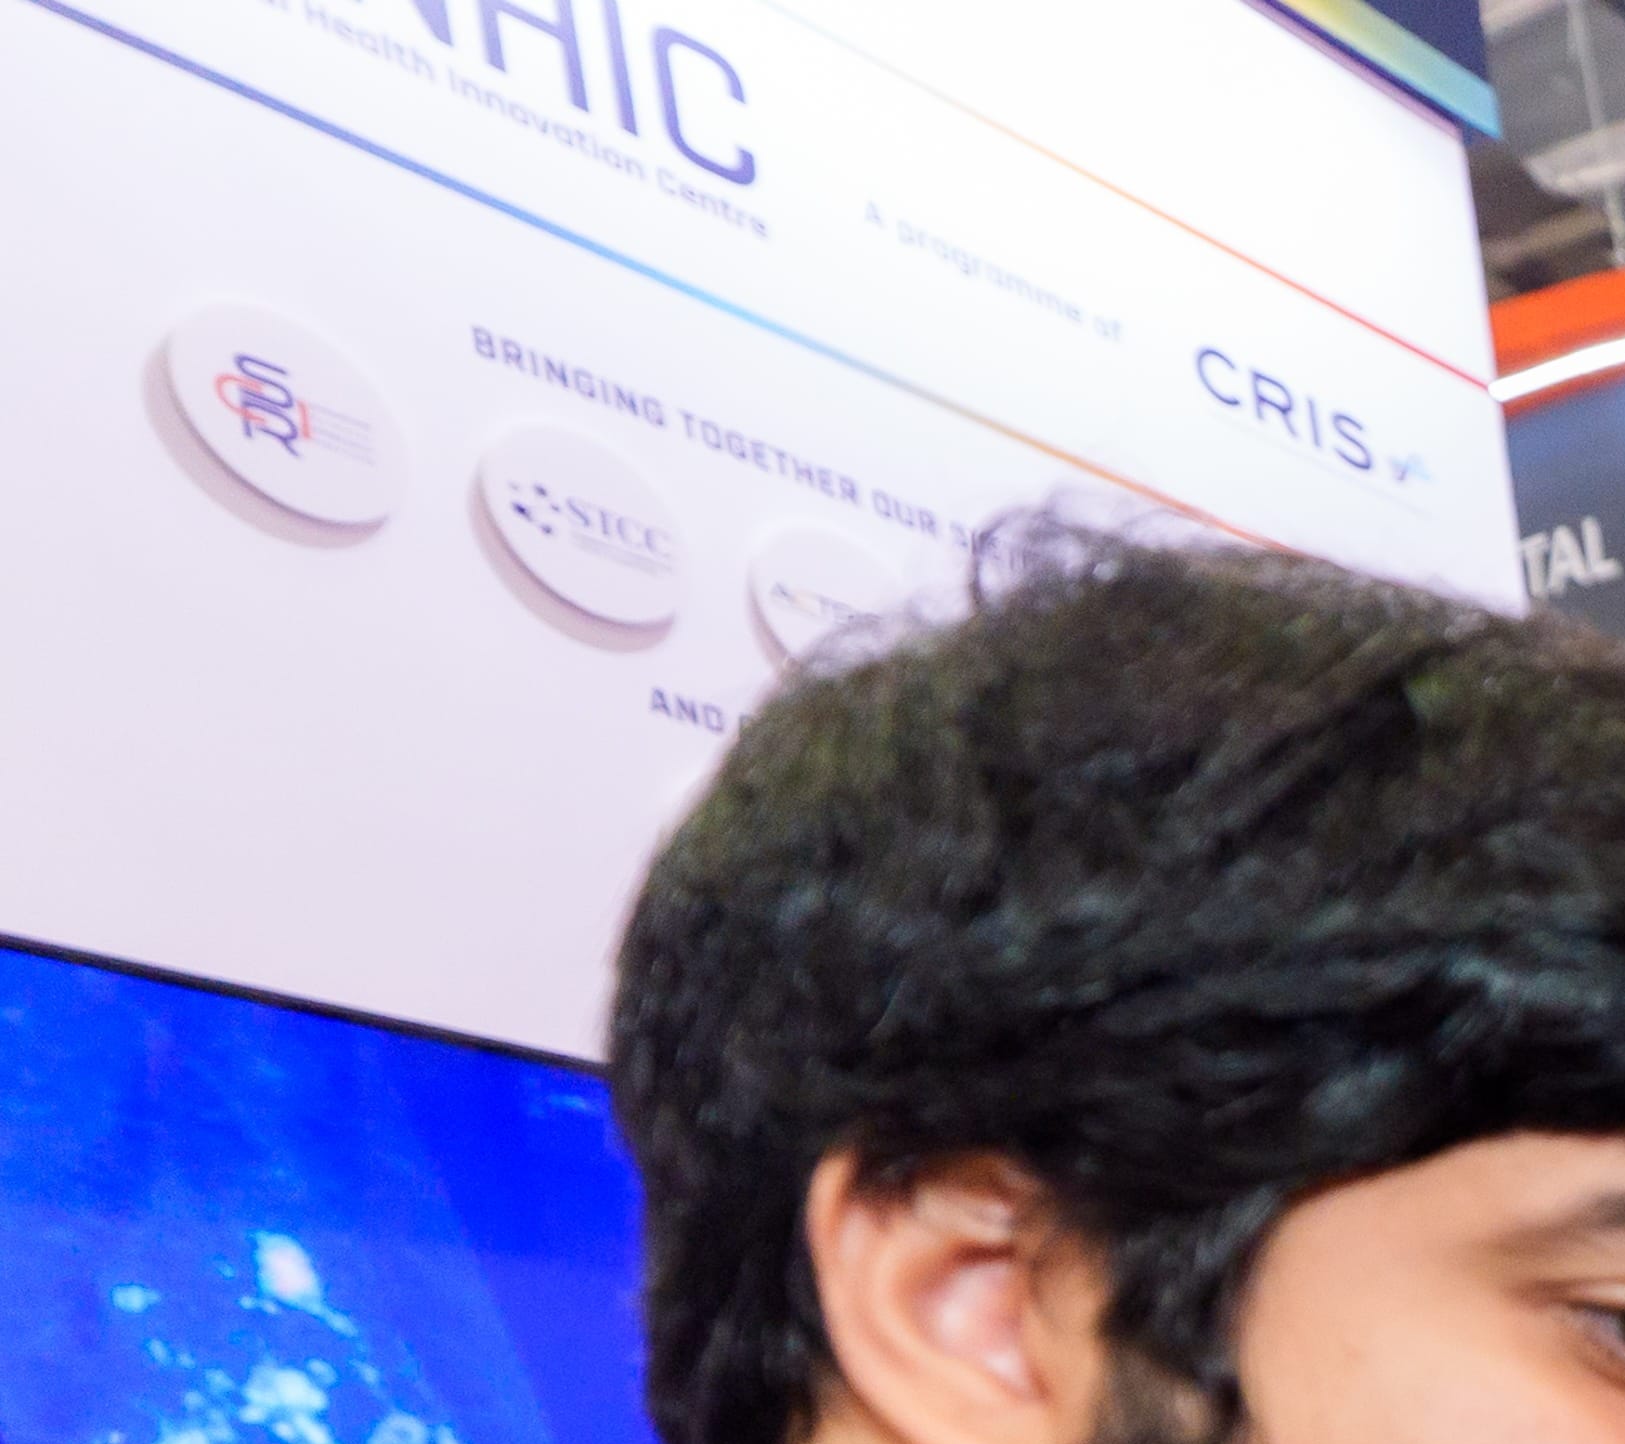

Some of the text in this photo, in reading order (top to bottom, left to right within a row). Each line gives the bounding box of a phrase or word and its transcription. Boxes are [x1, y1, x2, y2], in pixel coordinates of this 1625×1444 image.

[352, 0, 757, 186] HIC
[656, 166, 769, 240] Centre
[471, 325, 939, 538] BRINGING TOGETHER OUR
[1194, 344, 1375, 473] CRIS
[648, 686, 727, 736] AND
